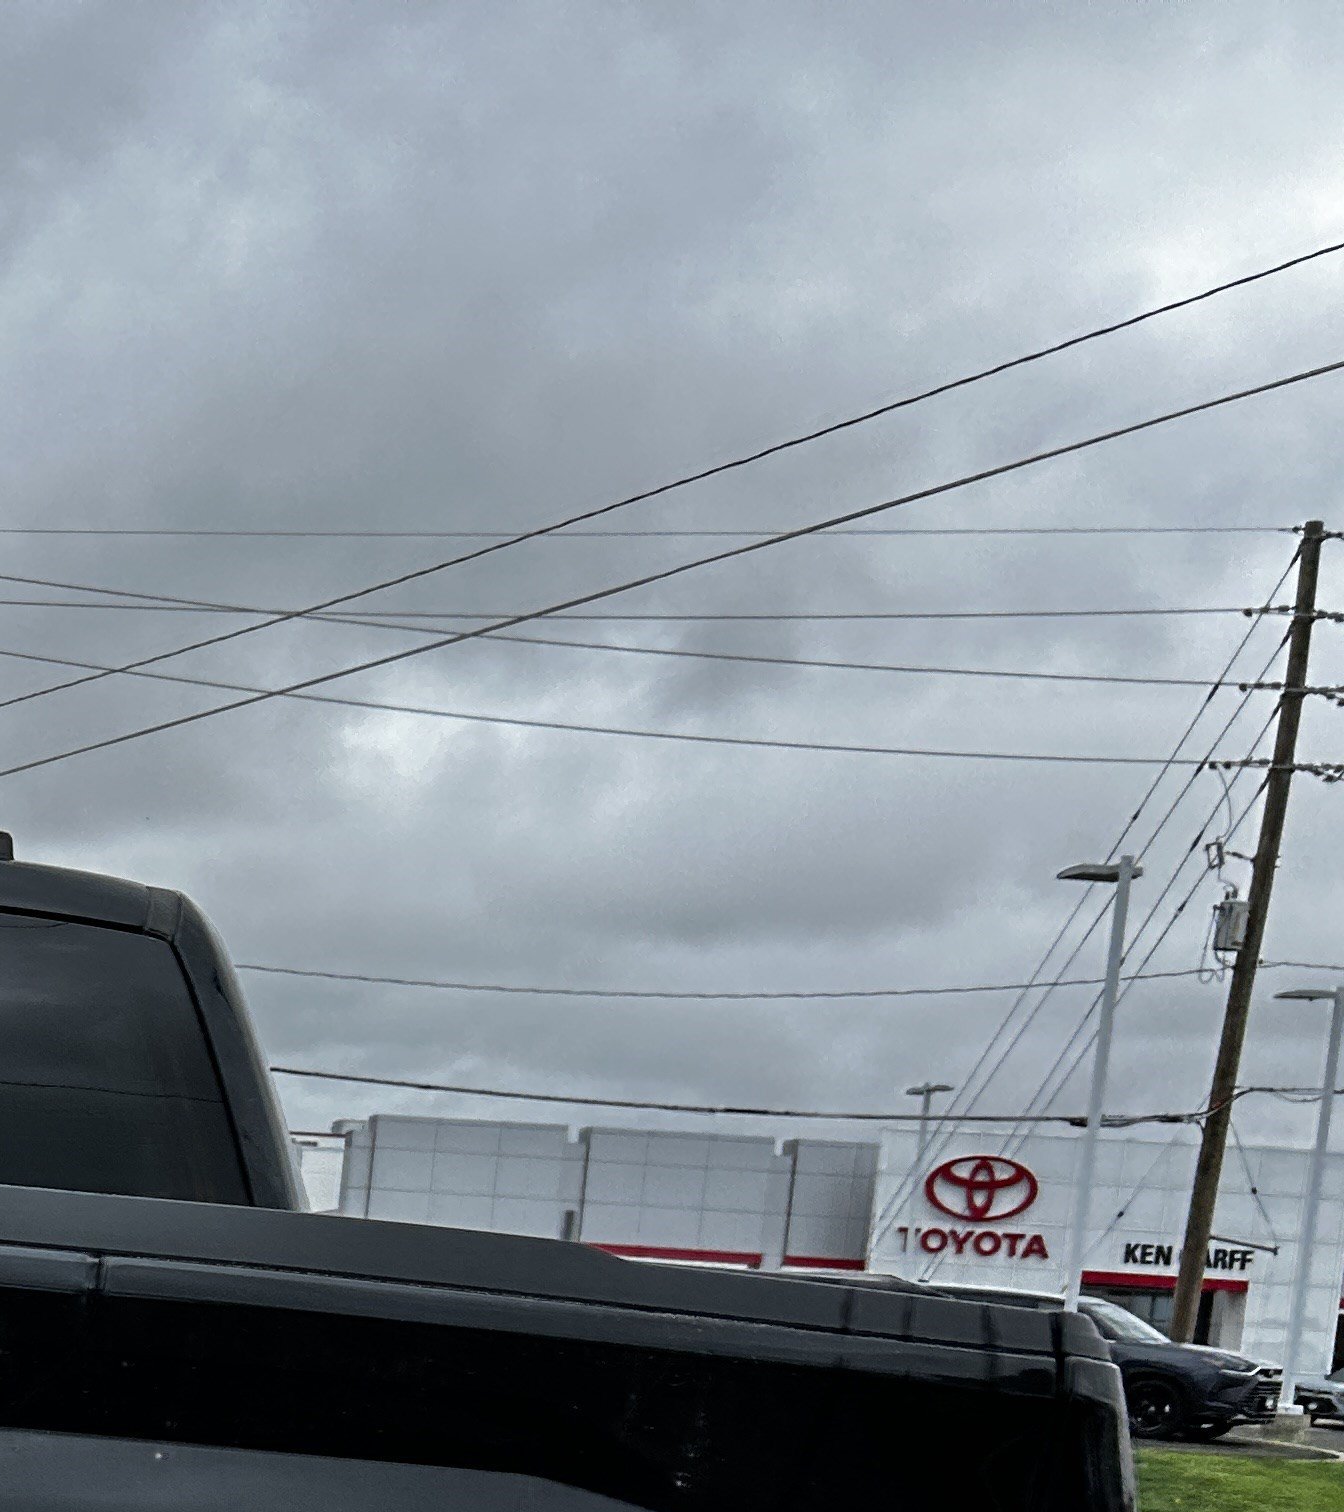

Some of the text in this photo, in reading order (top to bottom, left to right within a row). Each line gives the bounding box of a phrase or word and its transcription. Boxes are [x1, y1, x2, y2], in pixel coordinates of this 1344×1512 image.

[897, 1226, 1049, 1260] TOYOTA
[1123, 1243, 1254, 1270] KEN RFF
